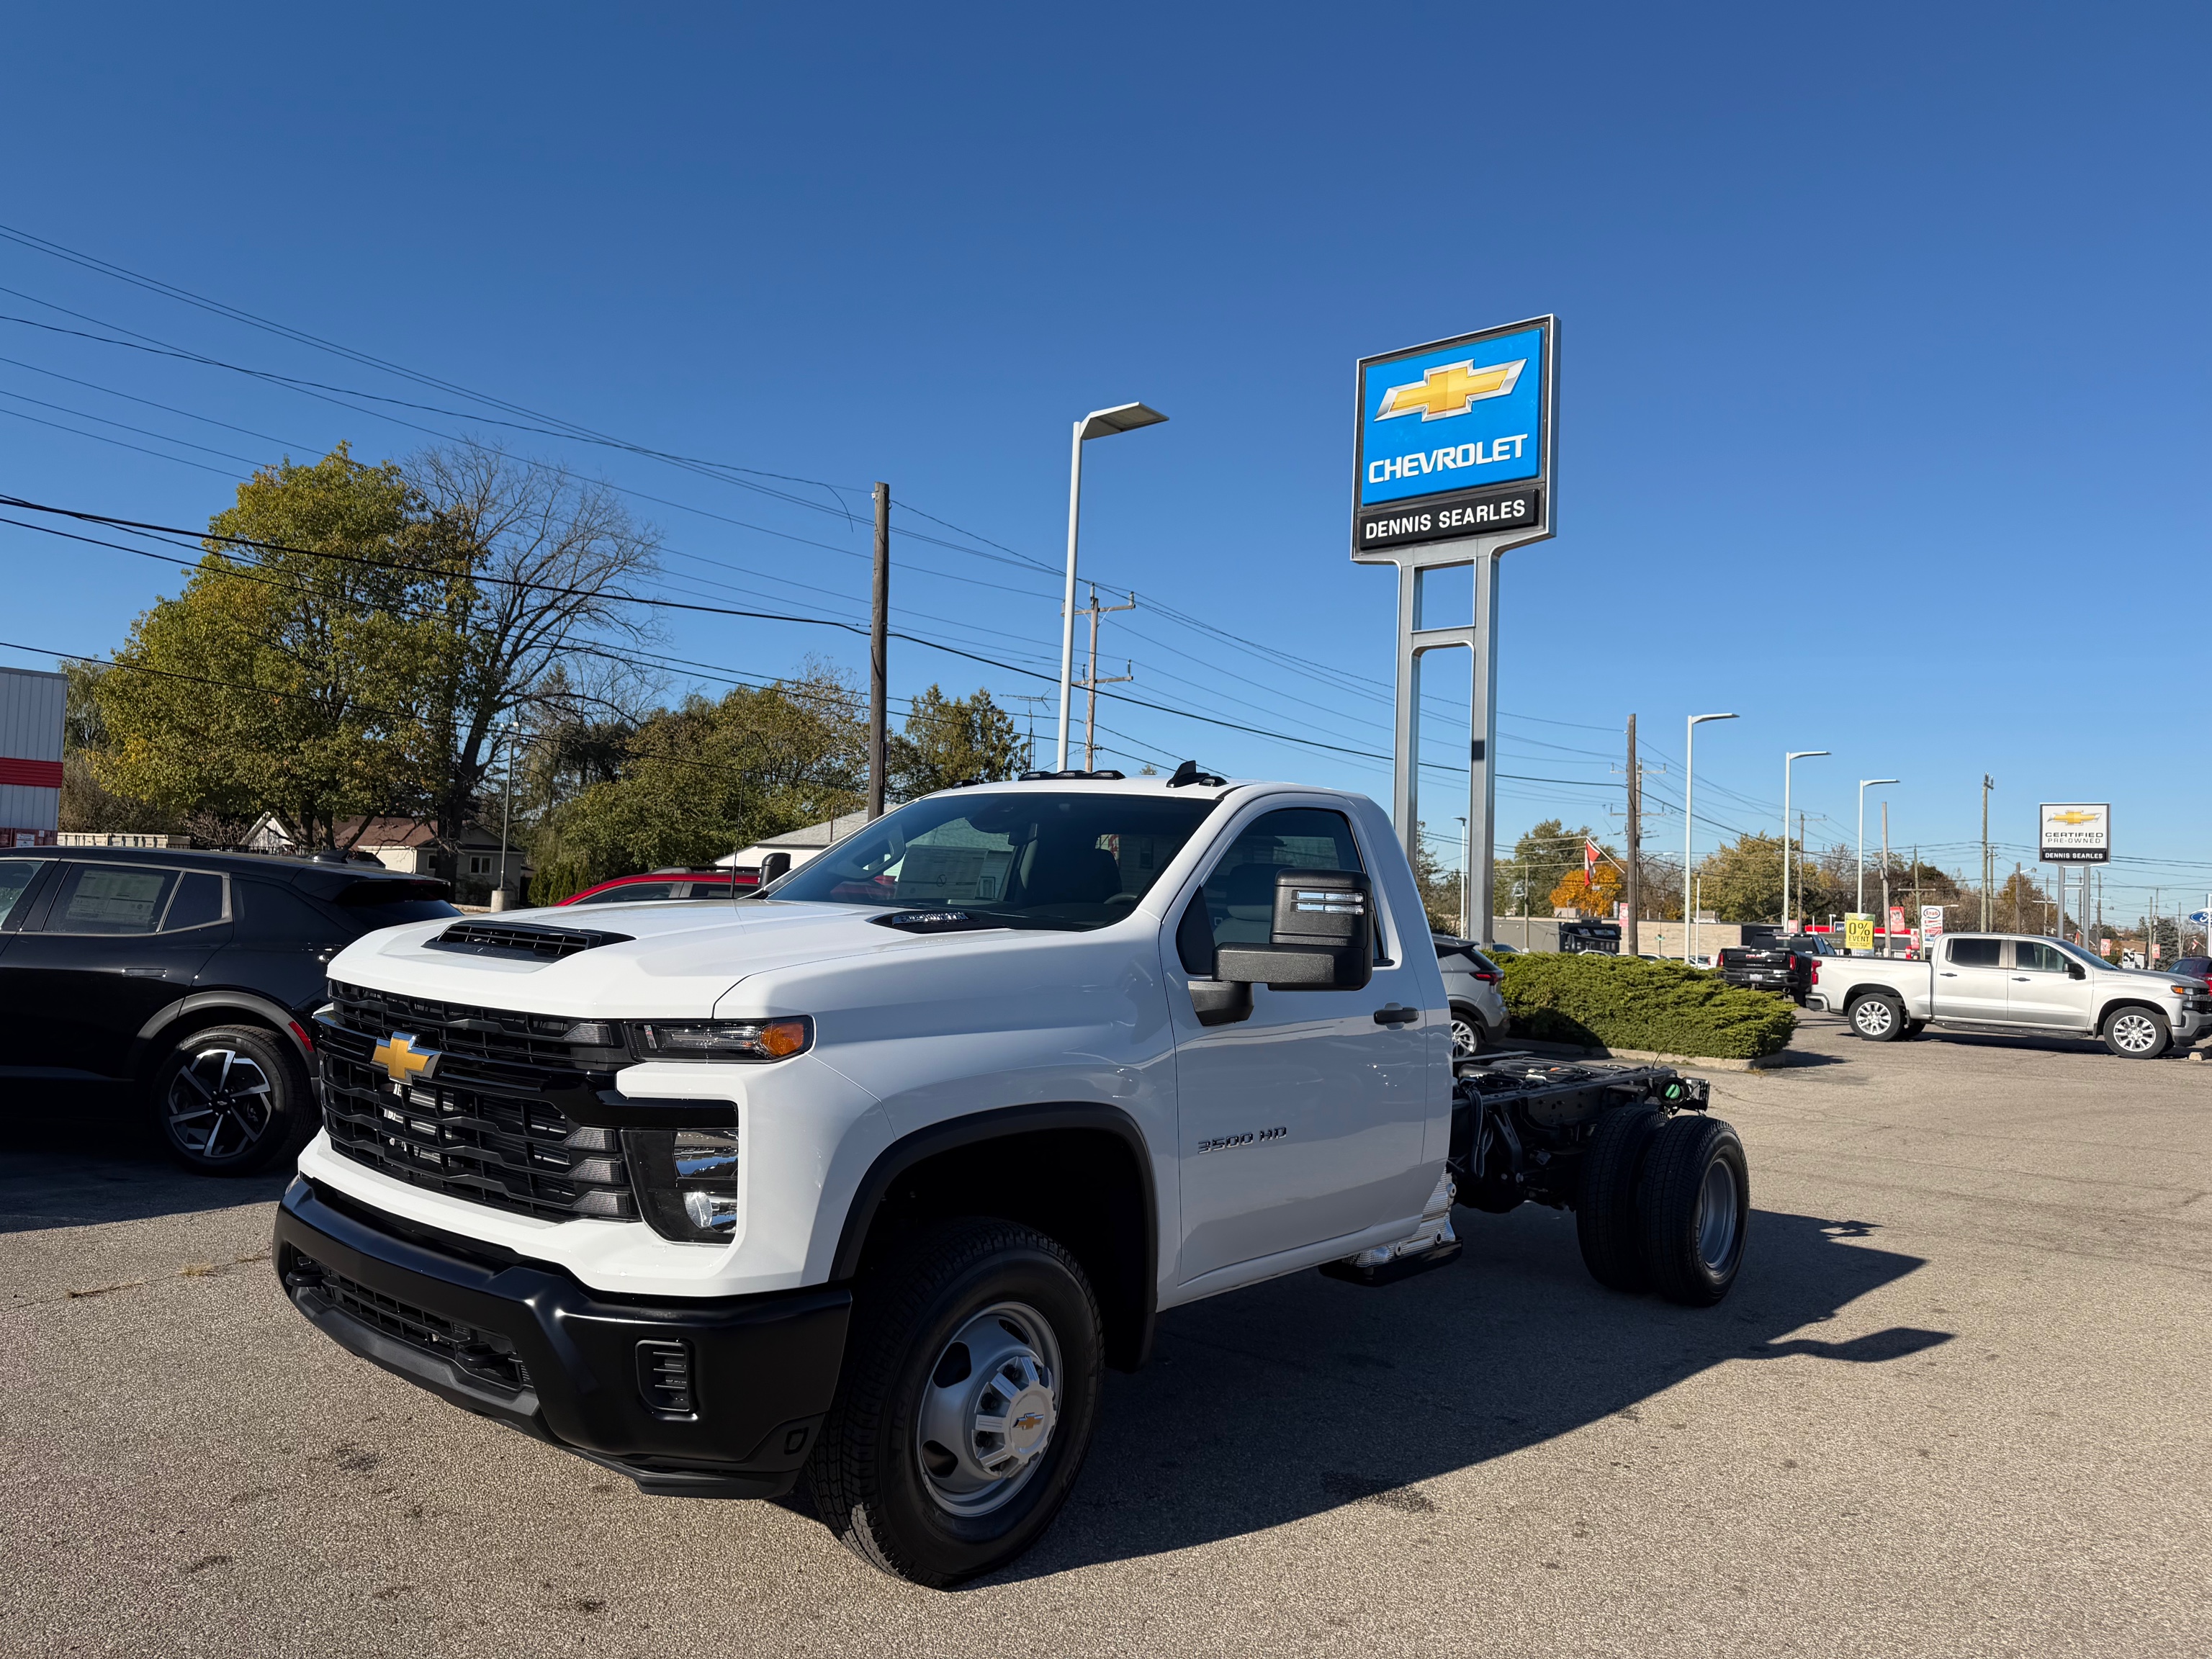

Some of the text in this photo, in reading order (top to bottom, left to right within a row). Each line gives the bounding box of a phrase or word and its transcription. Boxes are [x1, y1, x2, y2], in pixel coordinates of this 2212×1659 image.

[1369, 433, 1528, 484] CHEVROLET
[1366, 499, 1526, 539] DENNIS SEARLES
[1849, 922, 1871, 935] 0%
[1197, 1125, 1287, 1154] 3500 HD
